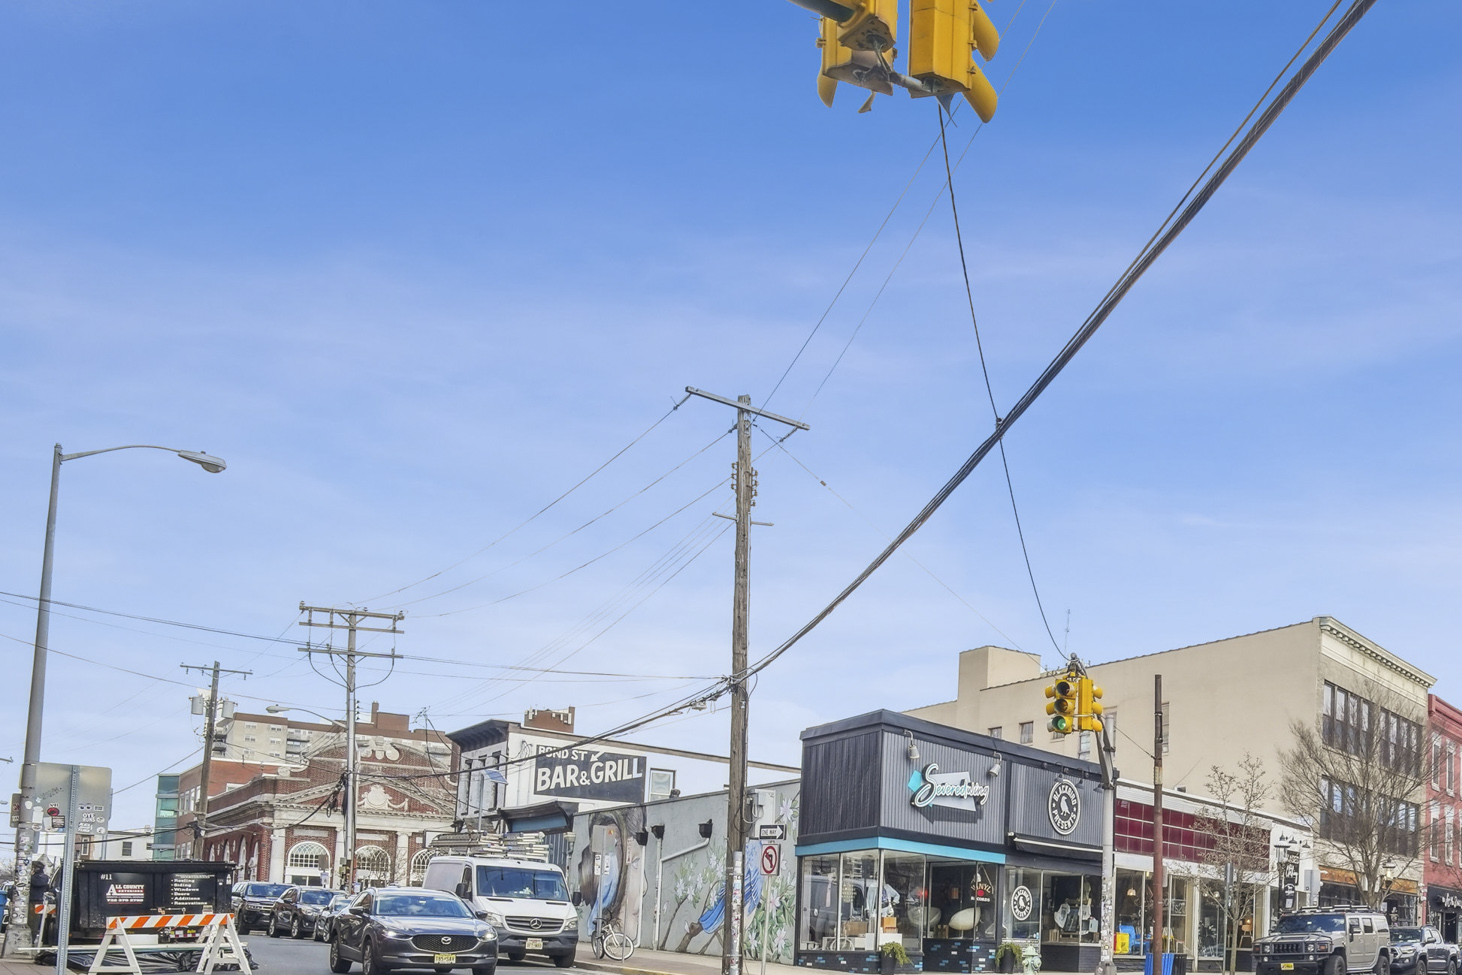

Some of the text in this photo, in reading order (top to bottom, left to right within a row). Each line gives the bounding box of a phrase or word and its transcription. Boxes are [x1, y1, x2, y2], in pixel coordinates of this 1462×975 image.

[538, 746, 588, 760] BOND ST
[1053, 785, 1077, 806] BLACKBIRD
[1052, 809, 1077, 830] PRESENTS
[106, 884, 123, 896] ALL
